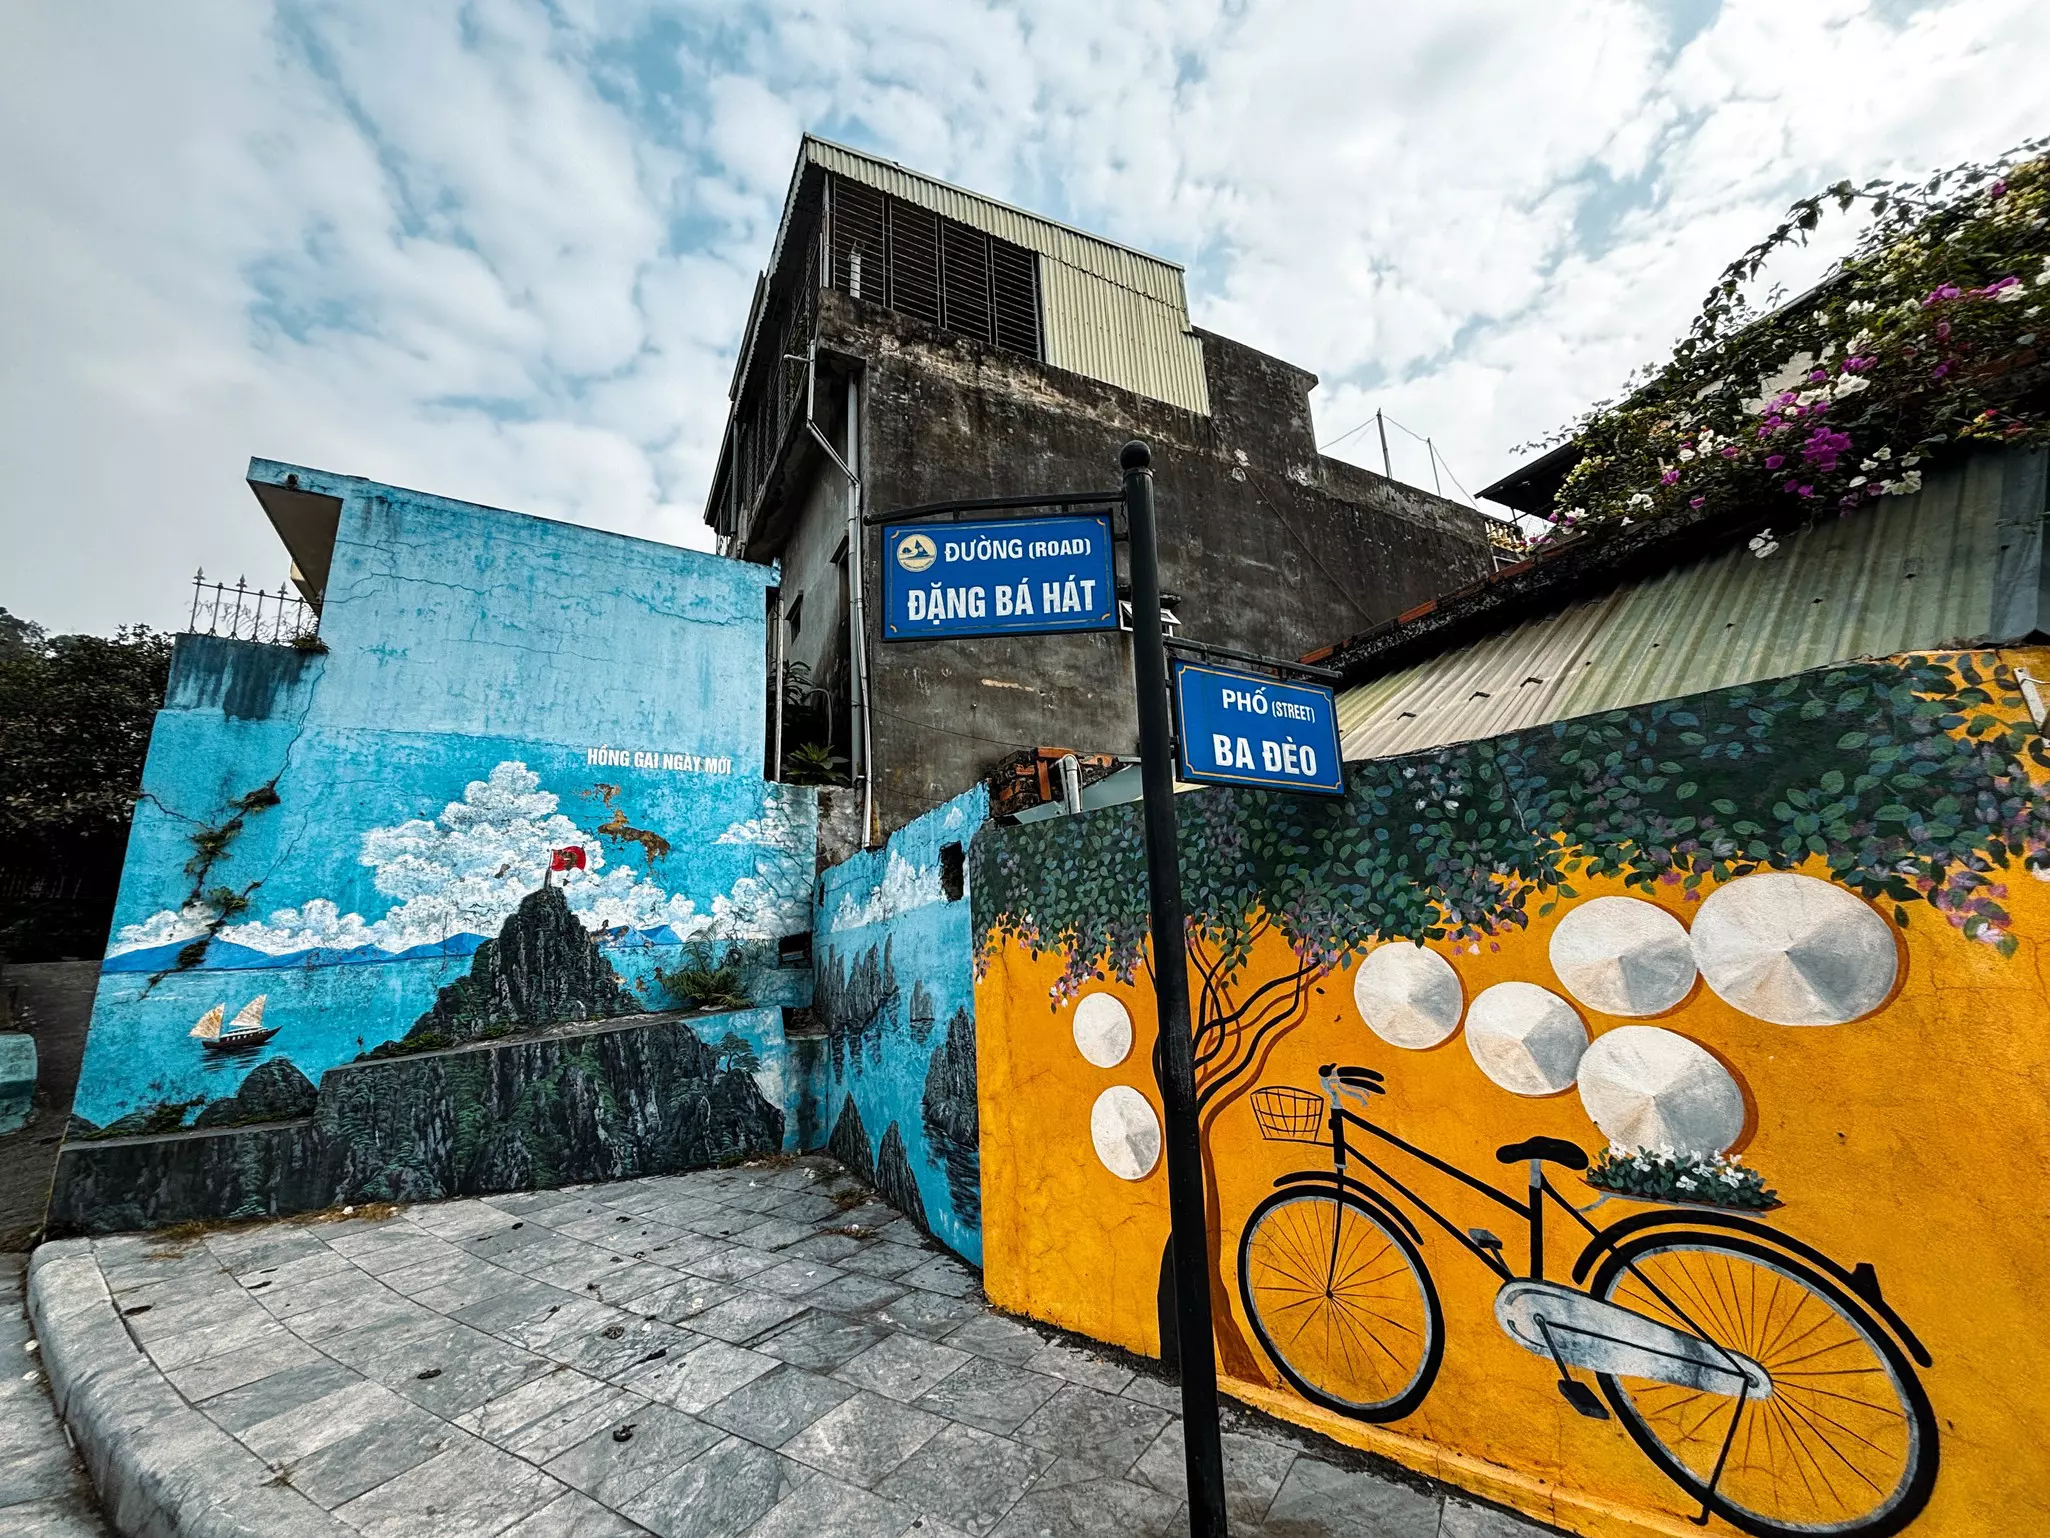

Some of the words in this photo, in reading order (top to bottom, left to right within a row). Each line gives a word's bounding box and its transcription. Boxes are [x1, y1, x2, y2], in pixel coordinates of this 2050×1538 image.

[944, 535, 1023, 562] ĐƯỜNG
[1028, 538, 1091, 560] (ROAD)
[907, 581, 986, 625] ĐẶNG
[995, 577, 1034, 617] BÁ
[1042, 574, 1096, 614] HÁT
[1221, 686, 1269, 715] PHỐ
[1271, 701, 1316, 724] (STREET)
[634, 751, 659, 769] GAI
[663, 752, 701, 772] NGÀY
[705, 755, 732, 775] MỚI
[1212, 733, 1256, 770] BA
[1261, 736, 1317, 777] ĐÈO
